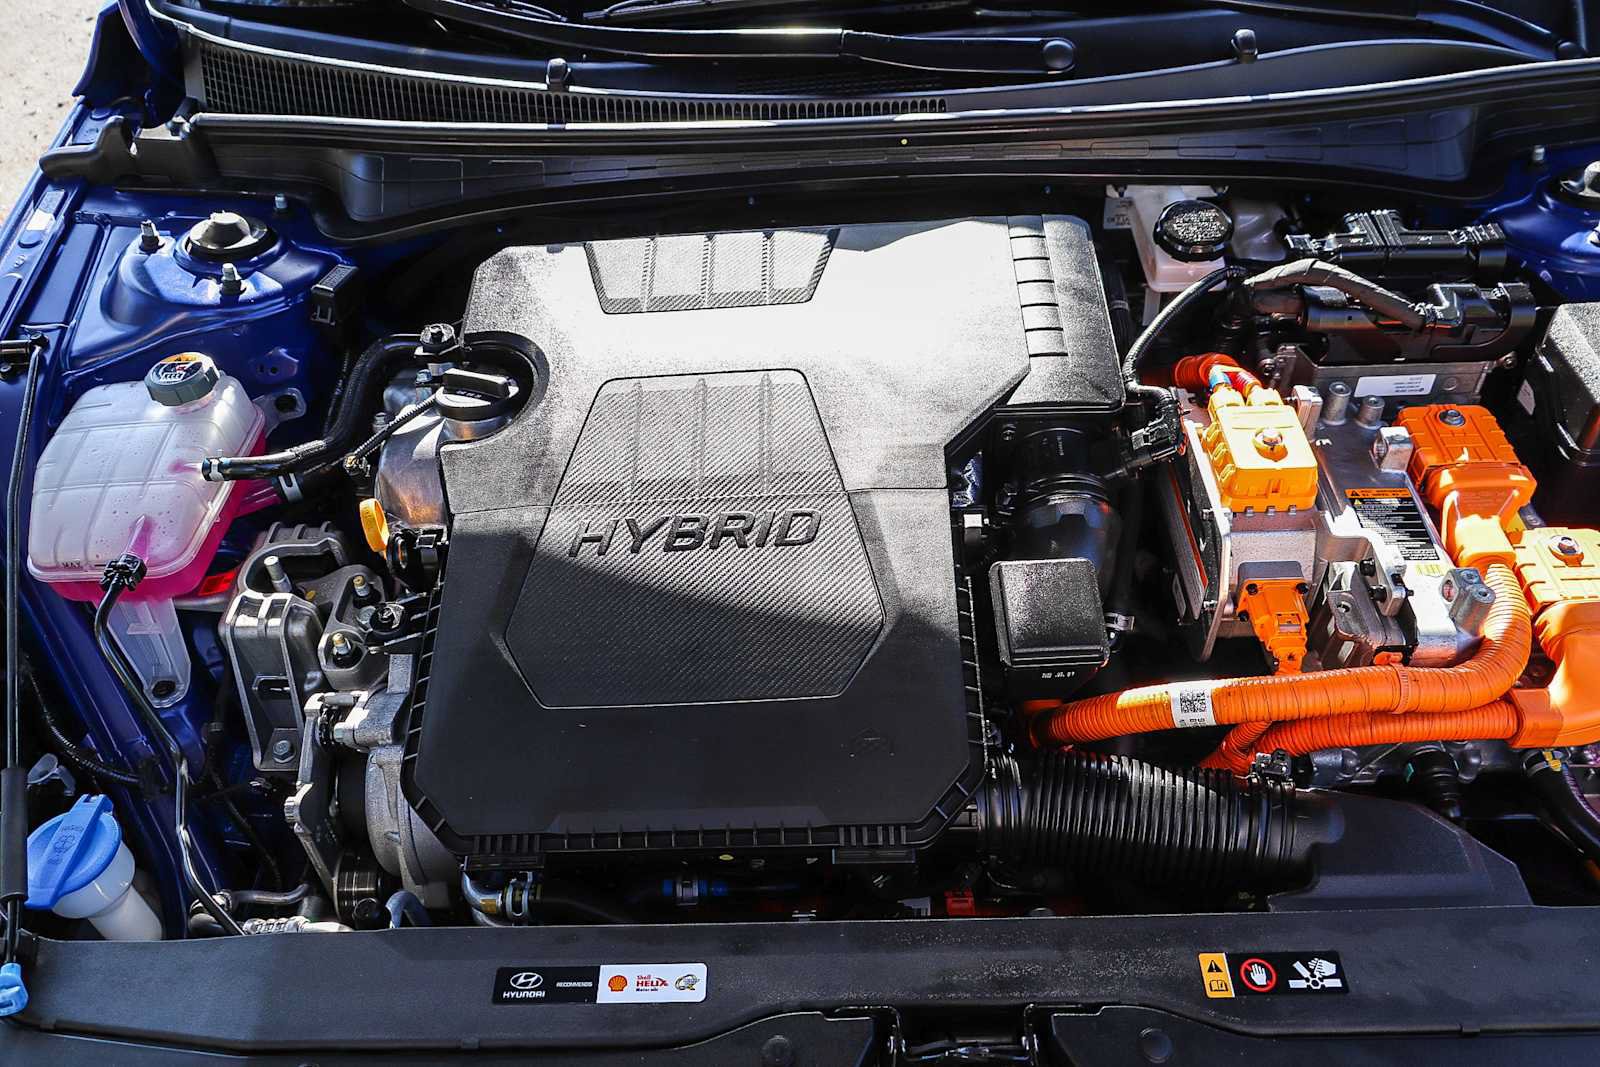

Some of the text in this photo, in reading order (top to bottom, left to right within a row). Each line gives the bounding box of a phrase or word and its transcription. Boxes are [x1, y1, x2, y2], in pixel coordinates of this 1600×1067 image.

[567, 508, 822, 558] HYBRID
[636, 977, 669, 987] HELIX
[503, 990, 546, 999] HYUNDAI
